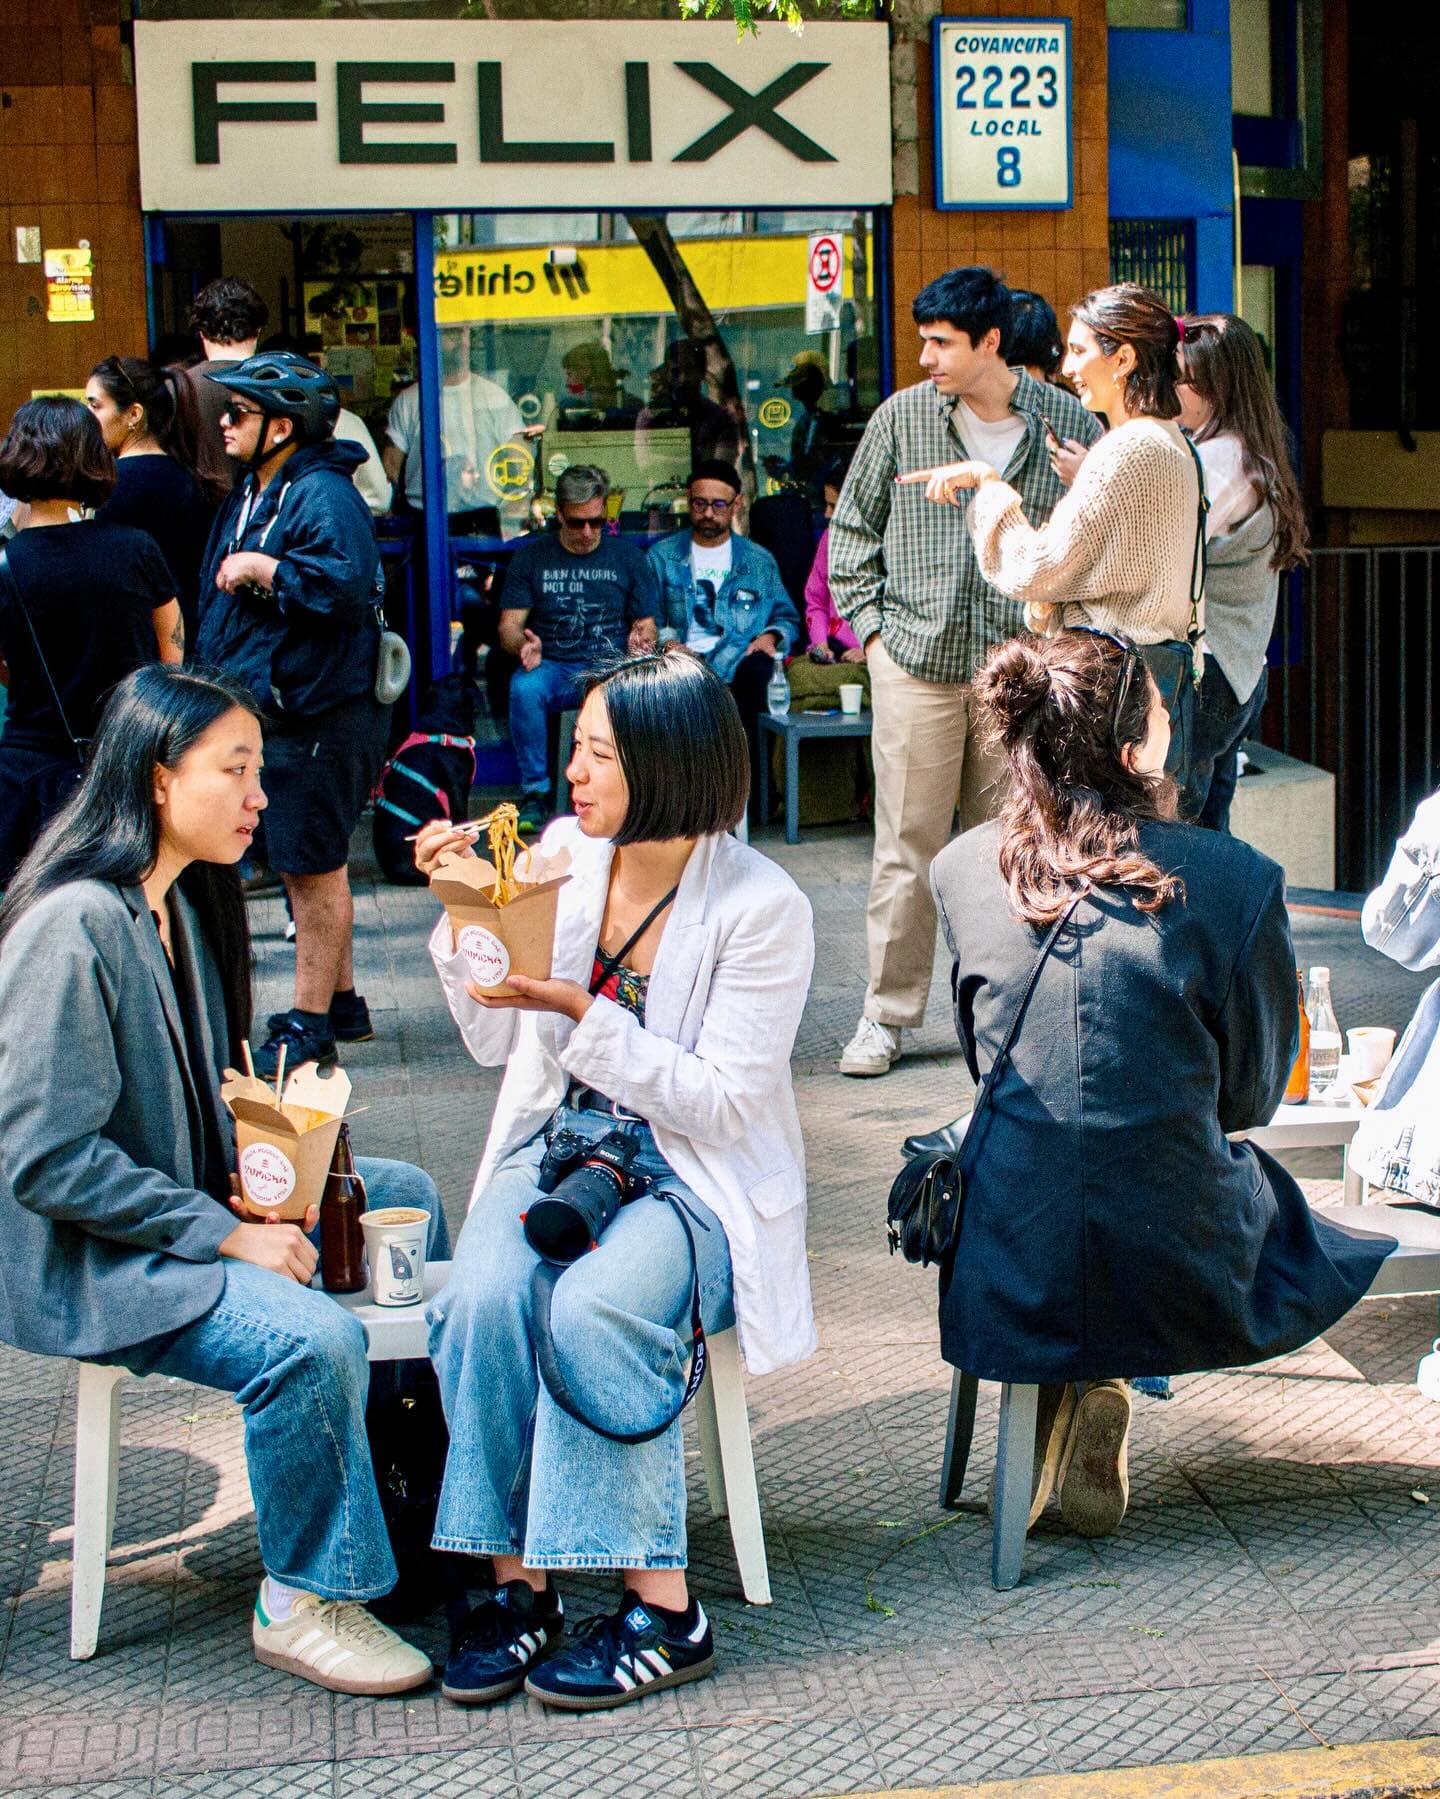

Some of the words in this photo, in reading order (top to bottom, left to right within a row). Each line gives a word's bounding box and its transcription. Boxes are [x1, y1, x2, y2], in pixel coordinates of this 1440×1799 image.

[954, 36, 1060, 54] COYANCURA
[955, 64, 1059, 110] 2223
[191, 60, 840, 165] FELIX
[970, 119, 1042, 136] LOCAL
[996, 146, 1022, 188] 8
[542, 581, 565, 593] NOT
[599, 1149, 620, 1161] SONY
